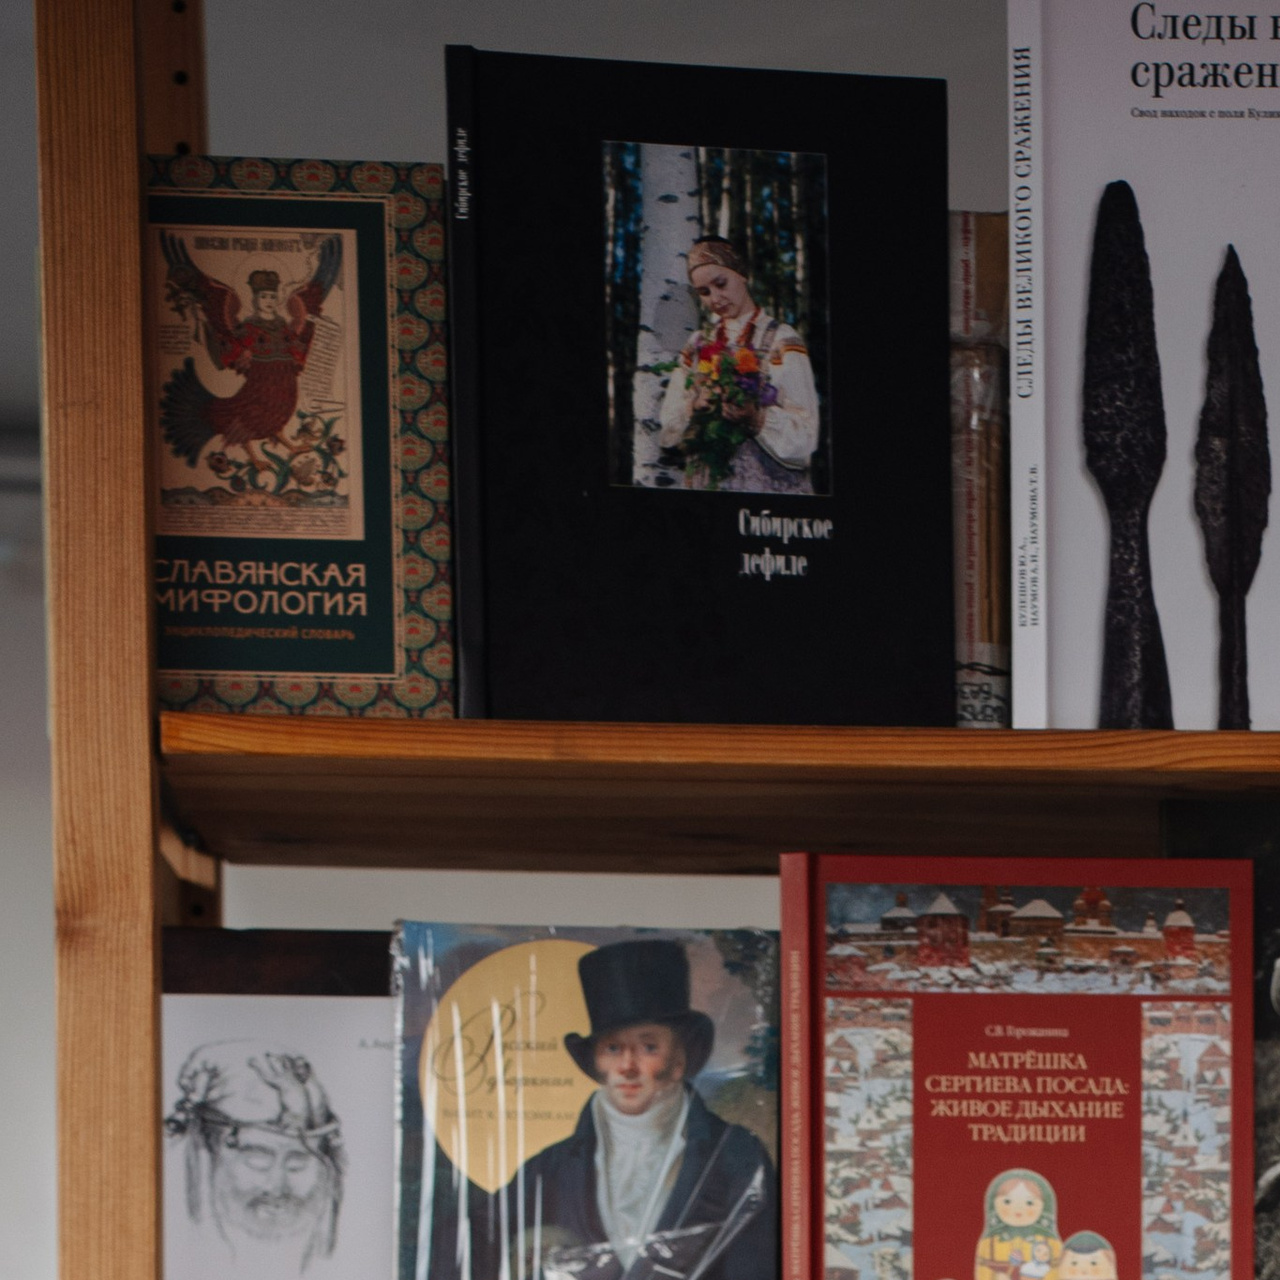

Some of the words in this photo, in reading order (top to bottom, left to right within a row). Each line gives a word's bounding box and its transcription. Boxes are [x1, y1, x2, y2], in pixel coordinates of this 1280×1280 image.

[1131, 2, 1258, 45] Следы
[1013, 47, 1032, 178] СРАЖЕНИЯ
[1131, 107, 1158, 120] Свод
[1160, 109, 1207, 118] находок
[1218, 109, 1245, 118] поля
[1015, 185, 1033, 310] ВЕЛИКОГО
[1016, 316, 1035, 399] СЛЕДЫ
[738, 507, 834, 545] Сибирское
[155, 559, 367, 588] СЛАВЯНСКАЯ
[738, 546, 809, 582] дефиле
[967, 1050, 1088, 1070] МАТРЁШКА
[924, 1074, 1033, 1094] СЕРГИЕВА
[1036, 1075, 1130, 1097] ПОСАДА:
[930, 1099, 1013, 1118] ЖИВОЕ
[1014, 1100, 1125, 1119] ДЫХАНИЕ
[967, 1123, 1086, 1143] ТРАДИЦИИ
